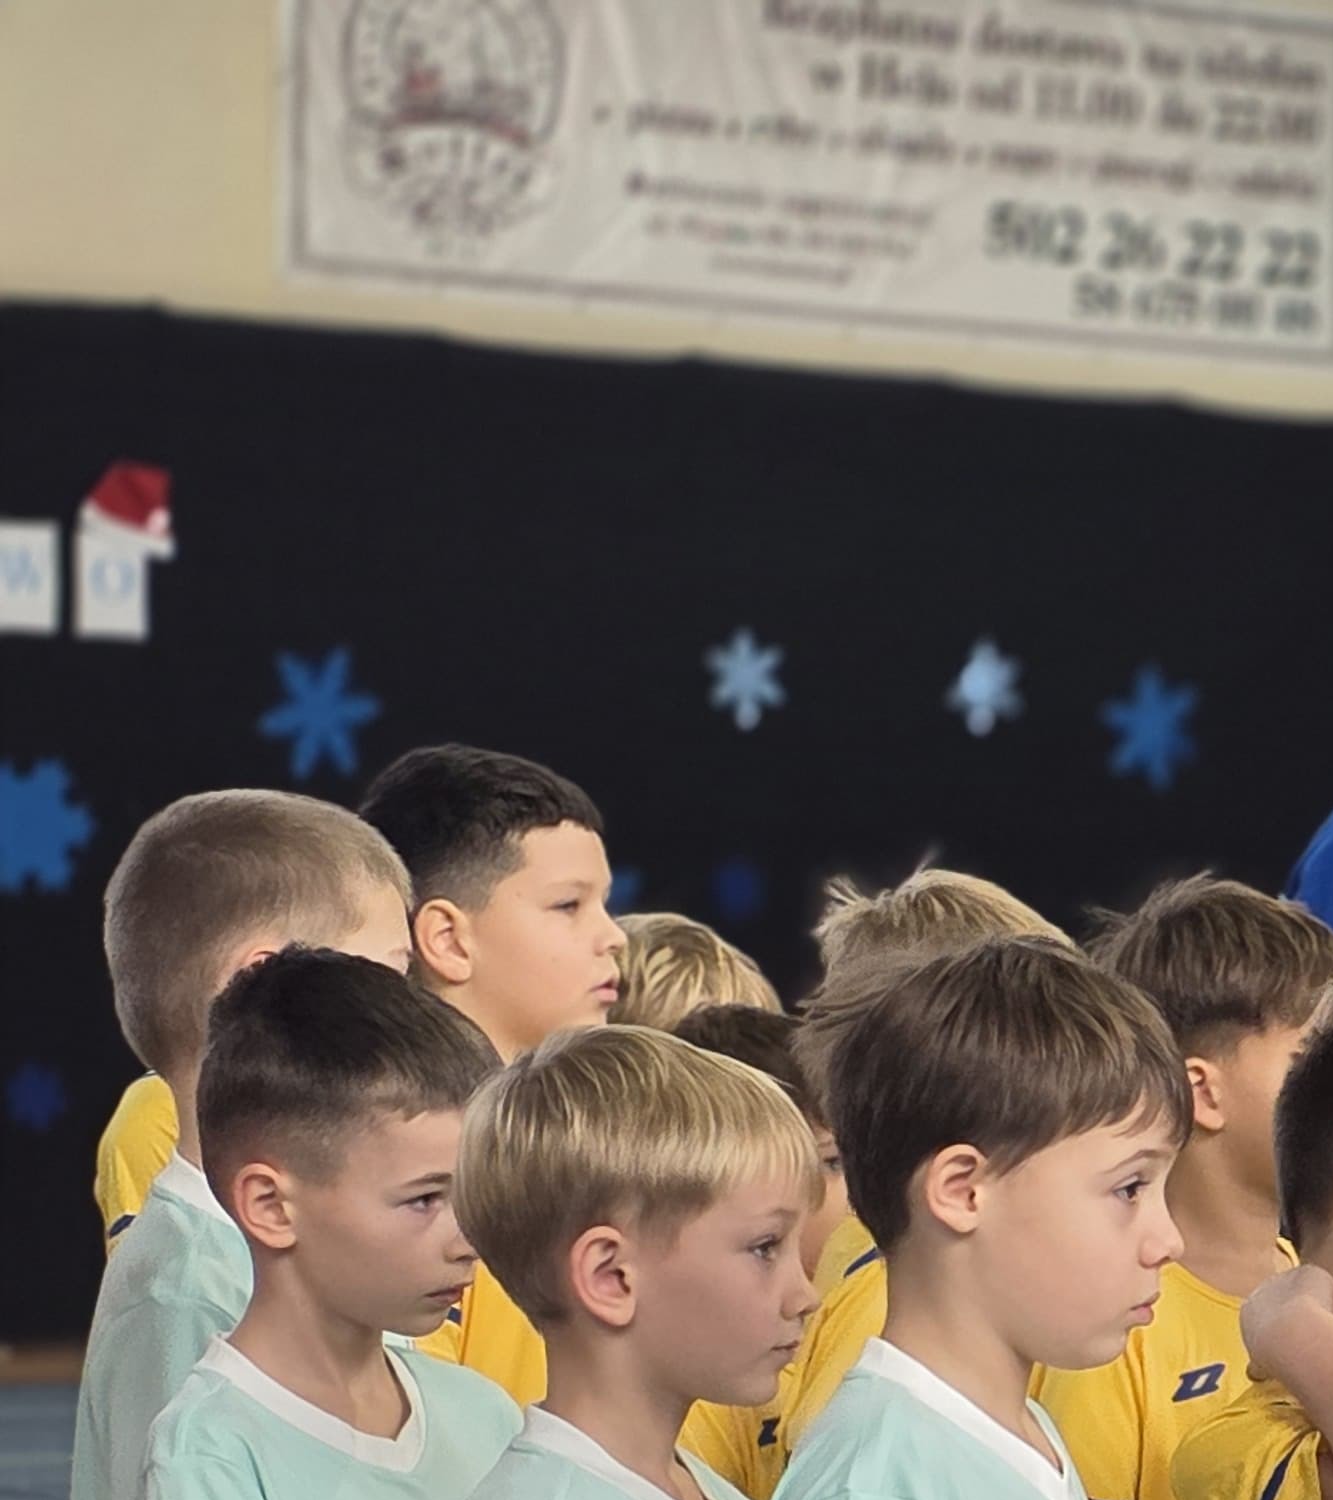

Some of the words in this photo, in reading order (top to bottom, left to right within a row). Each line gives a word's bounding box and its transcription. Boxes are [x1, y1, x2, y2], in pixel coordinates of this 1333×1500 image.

[987, 198, 1086, 265] 502
[1180, 220, 1244, 281] 22
[1258, 228, 1321, 289] 22
